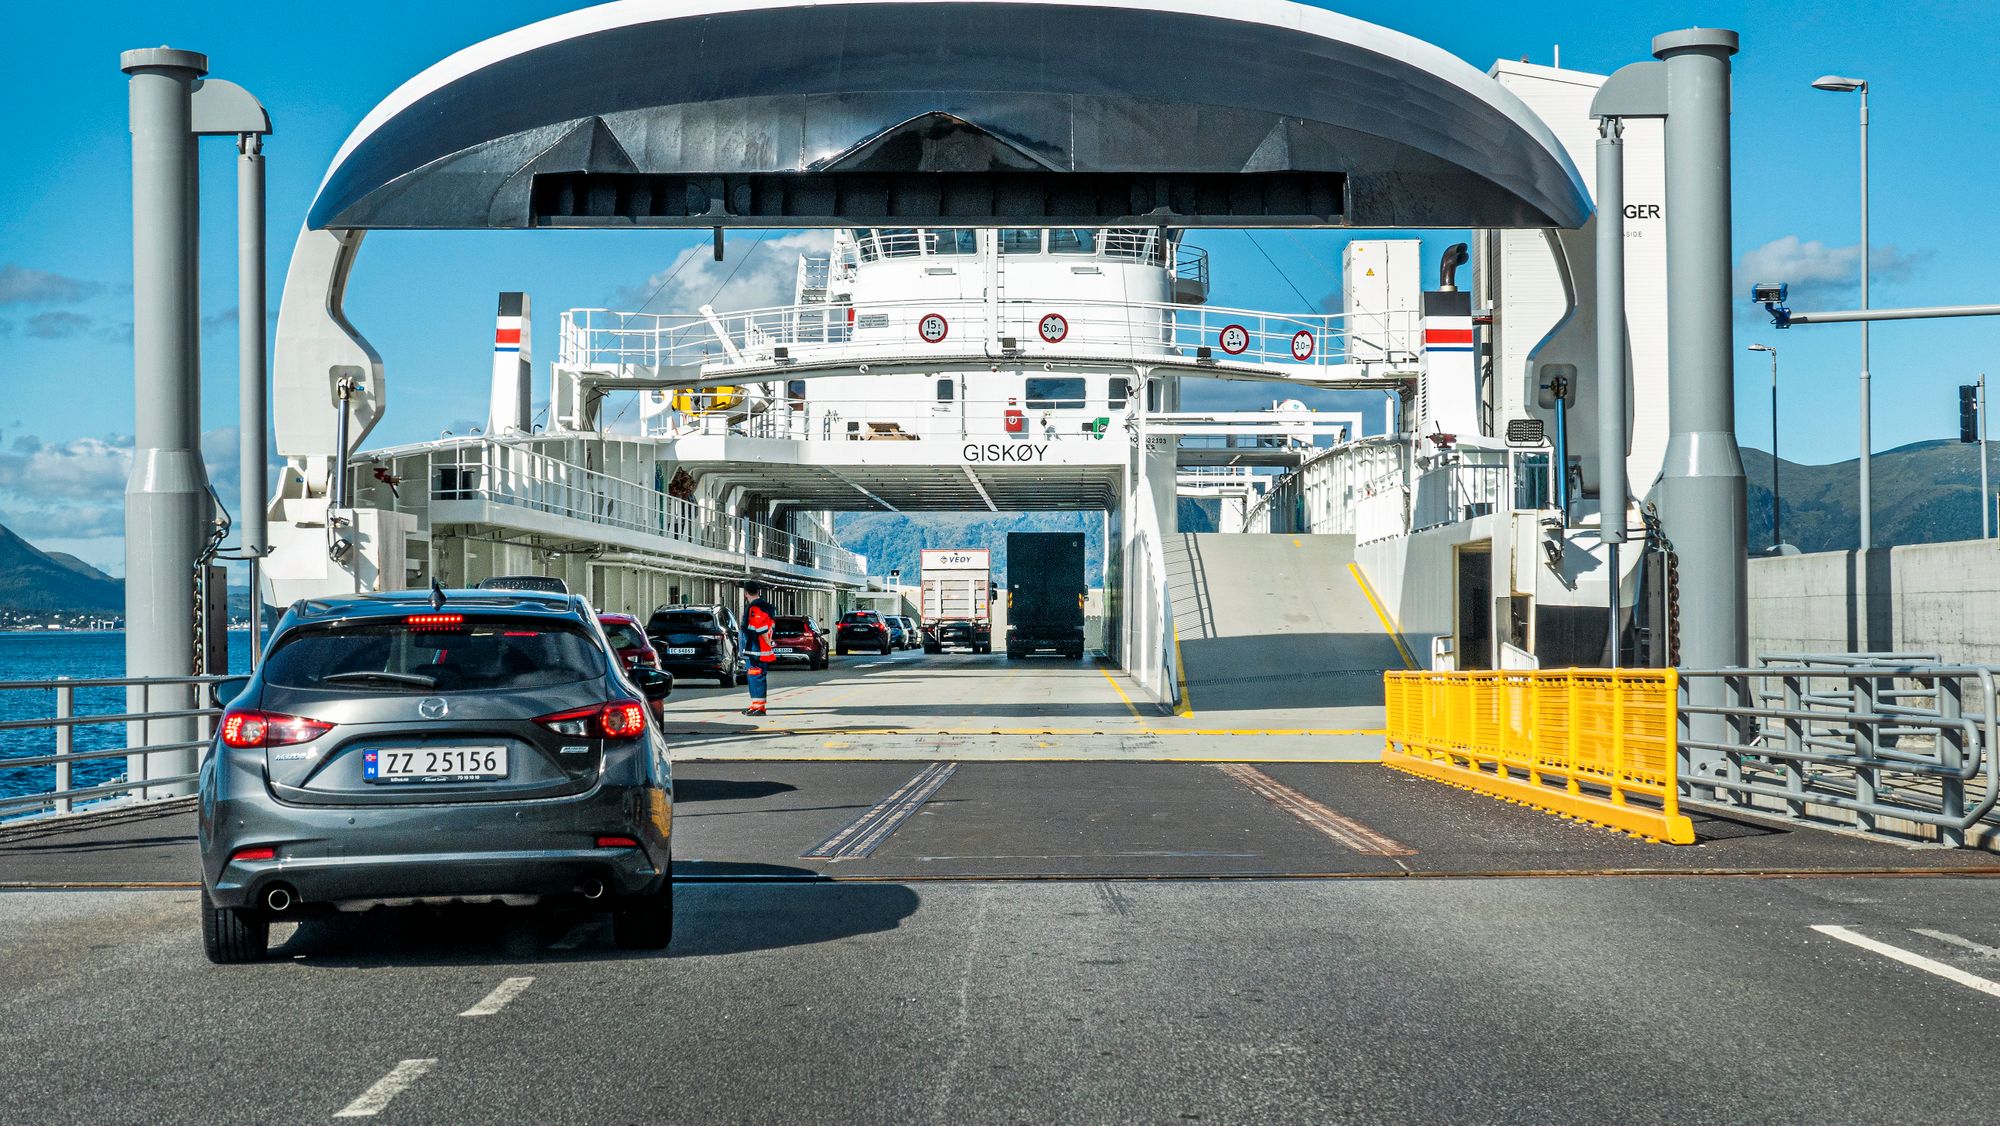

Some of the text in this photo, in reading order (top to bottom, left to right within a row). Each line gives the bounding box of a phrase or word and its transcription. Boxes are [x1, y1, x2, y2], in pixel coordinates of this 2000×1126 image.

[1623, 204, 1661, 219] GER
[926, 320, 937, 329] 15
[1229, 330, 1235, 340] 3
[963, 443, 1049, 462] GISKØY
[386, 751, 497, 774] ZZ 25156
